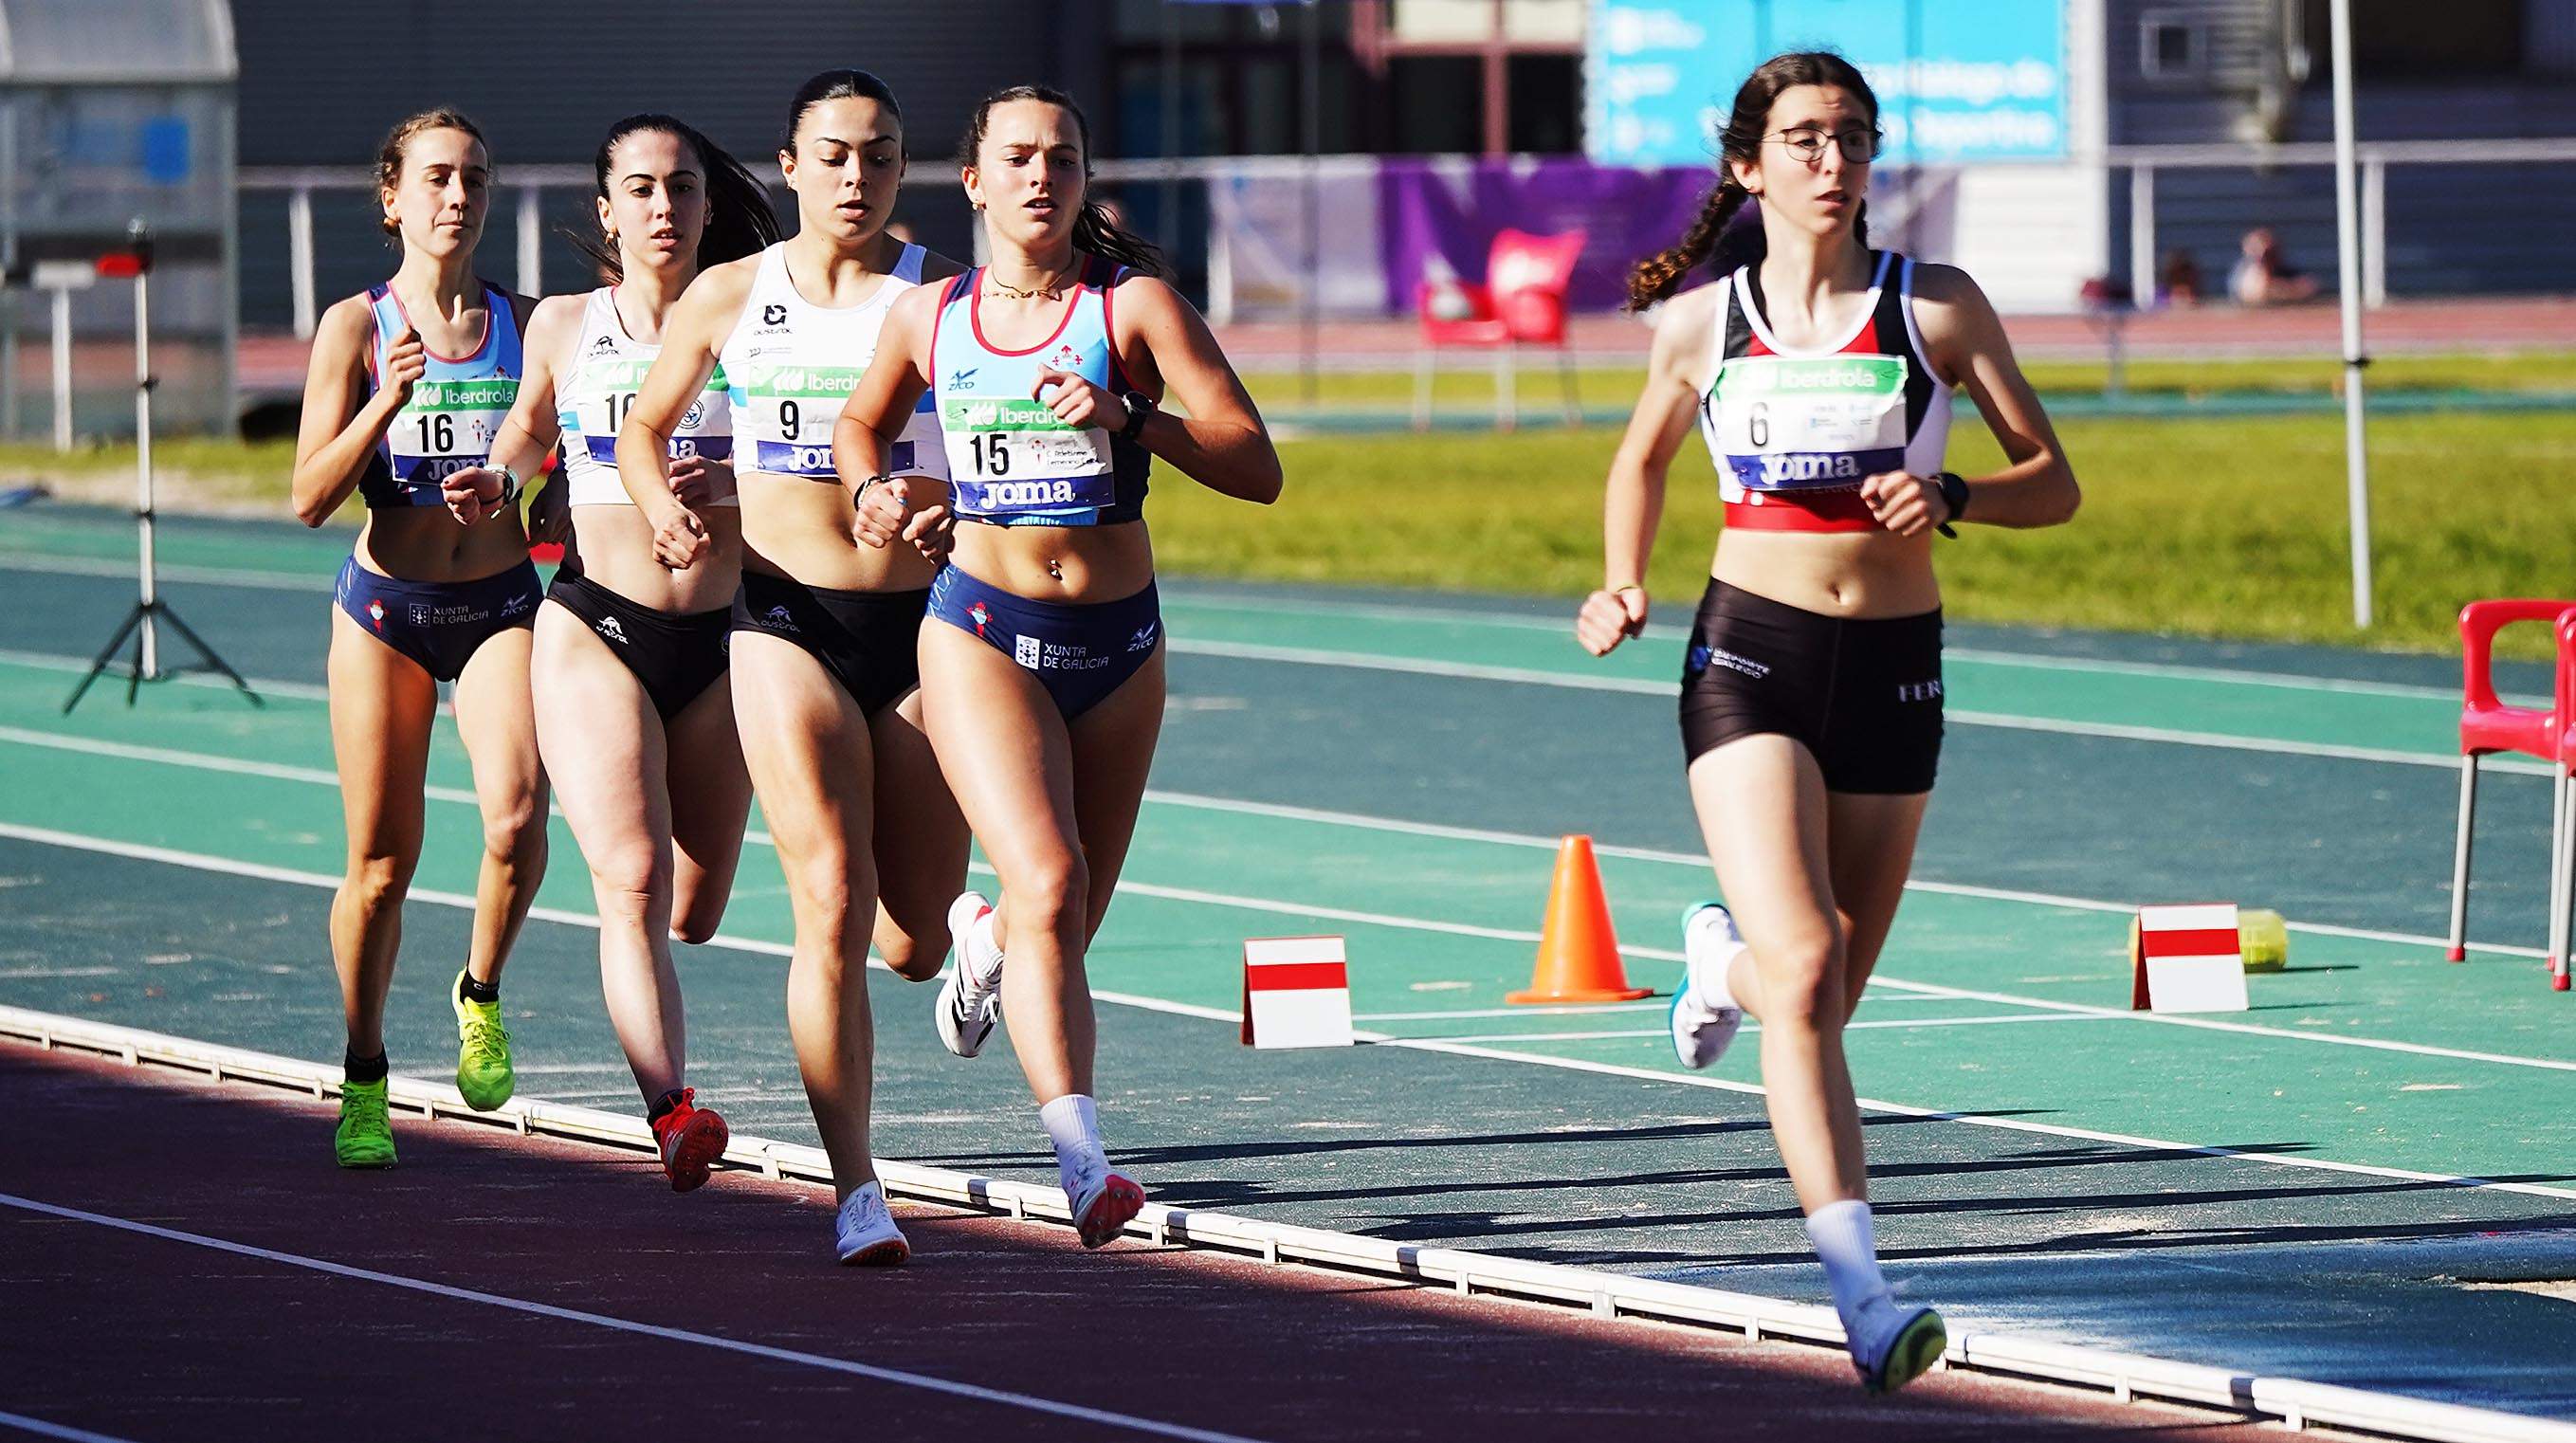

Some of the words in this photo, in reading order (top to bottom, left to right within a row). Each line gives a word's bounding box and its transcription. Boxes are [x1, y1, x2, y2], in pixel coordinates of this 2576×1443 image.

[808, 374, 862, 392] Iberdr
[445, 387, 515, 405] Iberdrola
[779, 399, 800, 441] 9
[1000, 406, 1066, 426] Iberdro
[1750, 401, 1769, 448] 6
[417, 413, 454, 453] 16
[788, 446, 834, 472] Jo
[970, 433, 1010, 476] 15
[432, 616, 447, 625] DE
[448, 610, 489, 625] GALICIA
[433, 605, 469, 615] XUNTA
[1044, 643, 1087, 658] XUNTA
[1043, 655, 1059, 669] DE
[1061, 656, 1109, 670] GALICIA
